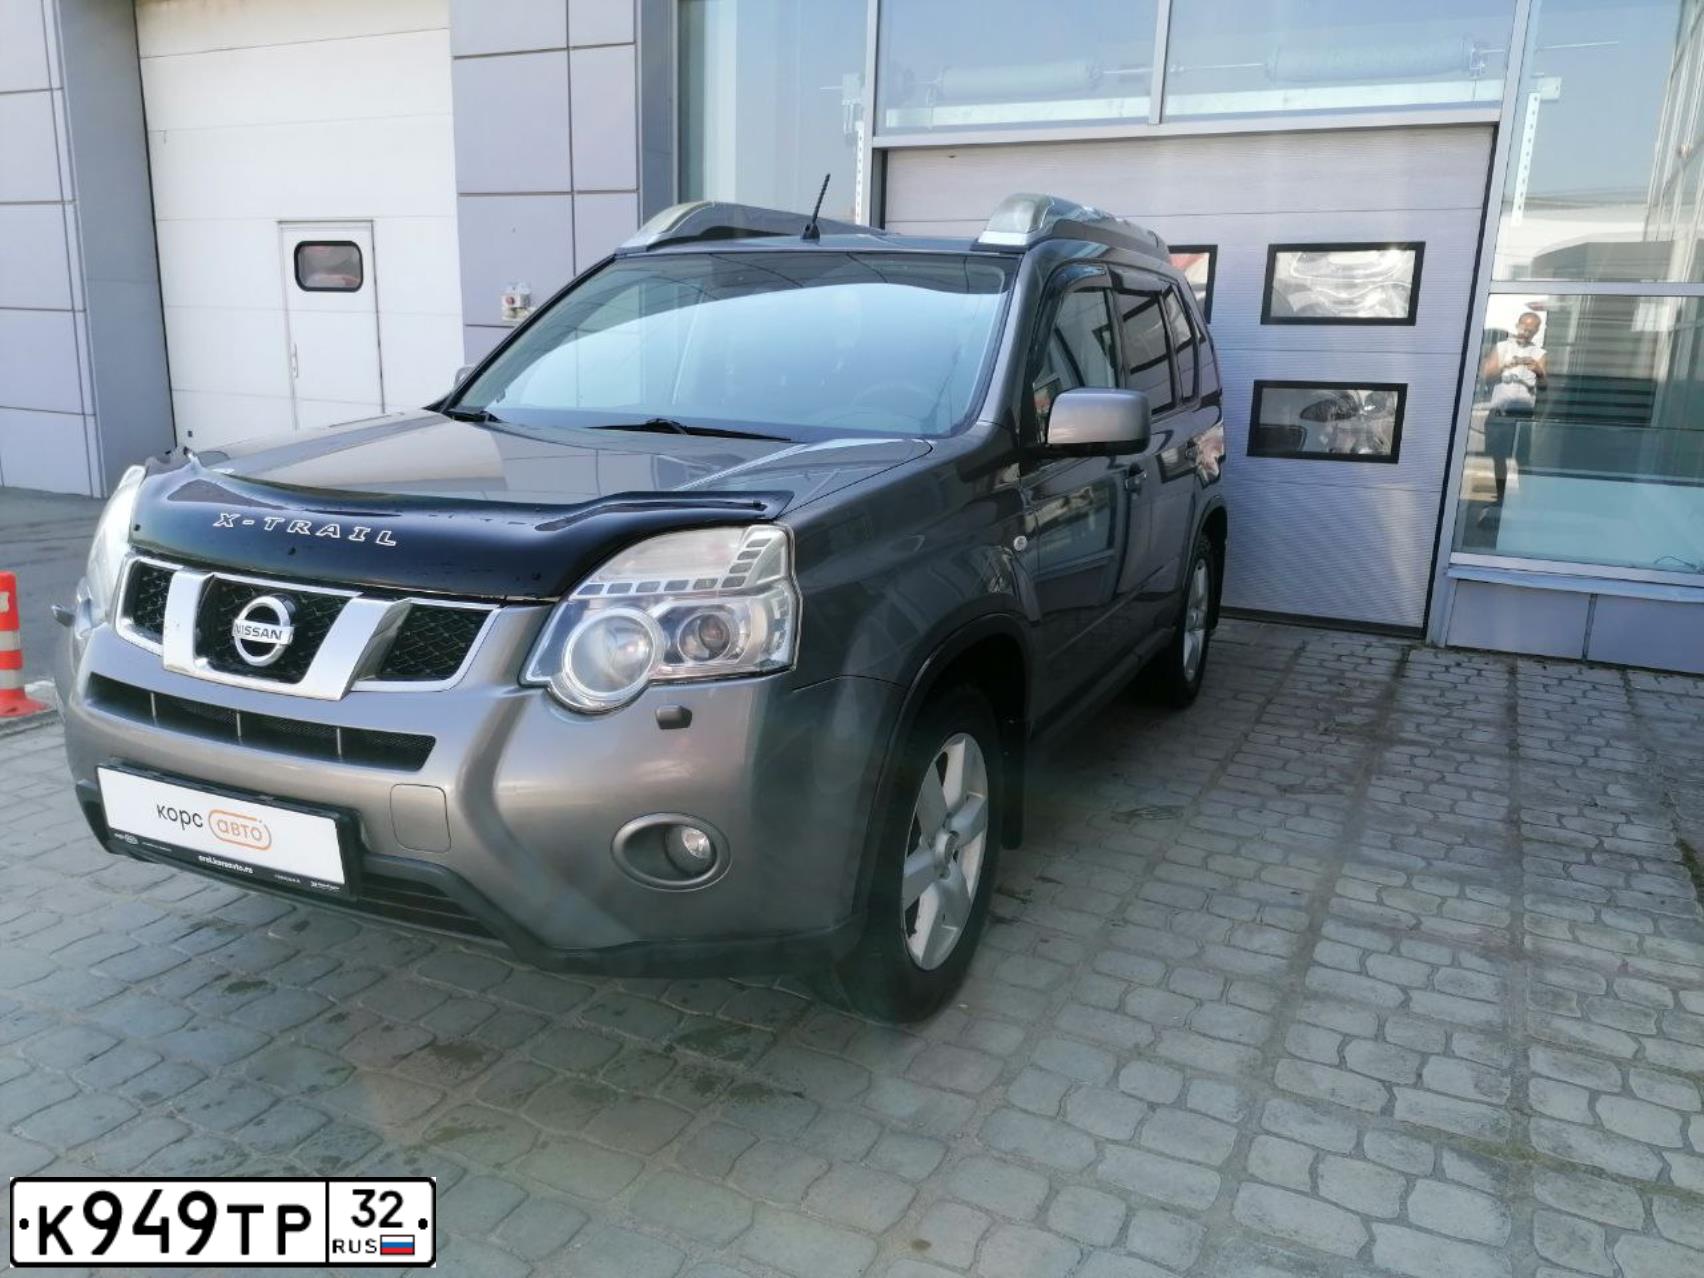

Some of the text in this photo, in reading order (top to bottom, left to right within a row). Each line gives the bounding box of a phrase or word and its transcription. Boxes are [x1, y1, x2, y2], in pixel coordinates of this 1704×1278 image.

[213, 513, 397, 546] X-TRAIL
[234, 623, 283, 640] NISSAN
[156, 804, 204, 831] корс
